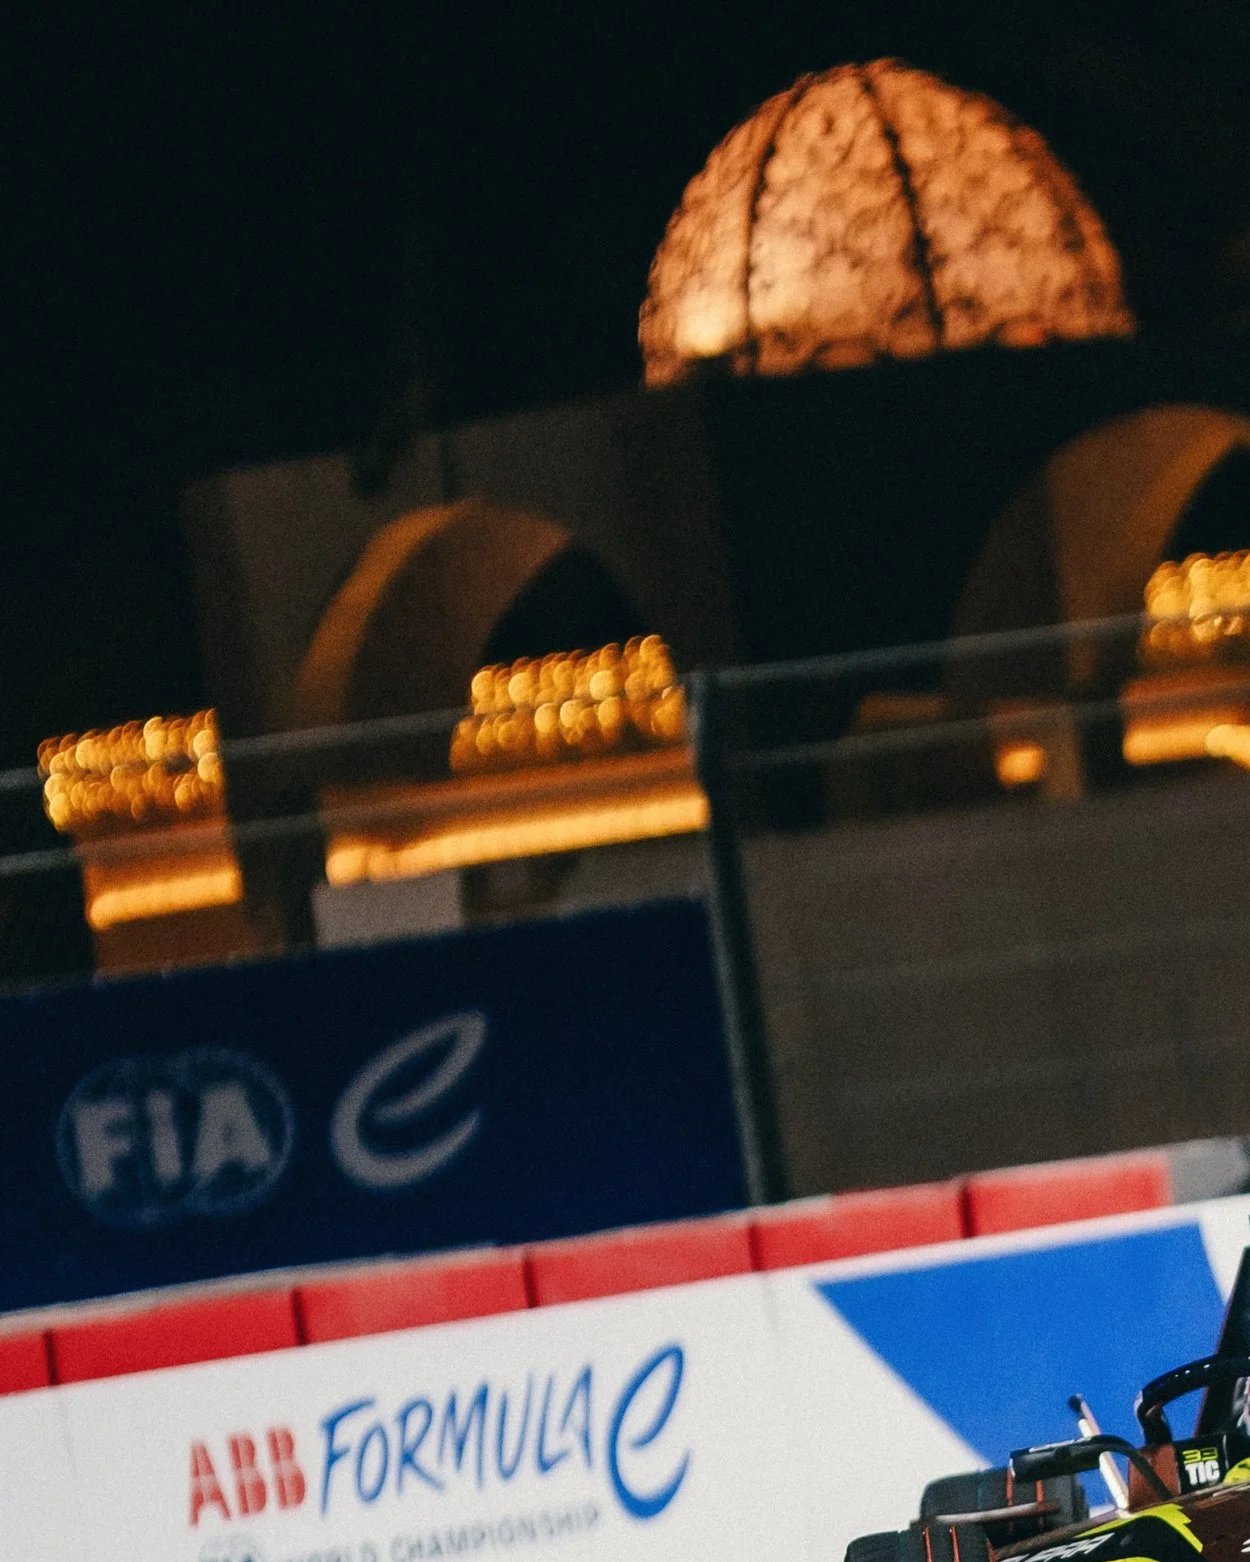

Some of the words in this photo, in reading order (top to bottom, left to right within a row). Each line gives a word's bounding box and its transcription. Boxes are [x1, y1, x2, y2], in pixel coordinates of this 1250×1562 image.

[74, 1080, 272, 1200] FIA
[187, 1424, 307, 1527] ABB
[317, 1361, 595, 1519] FORMULA
[1185, 1461, 1221, 1485] TIC
